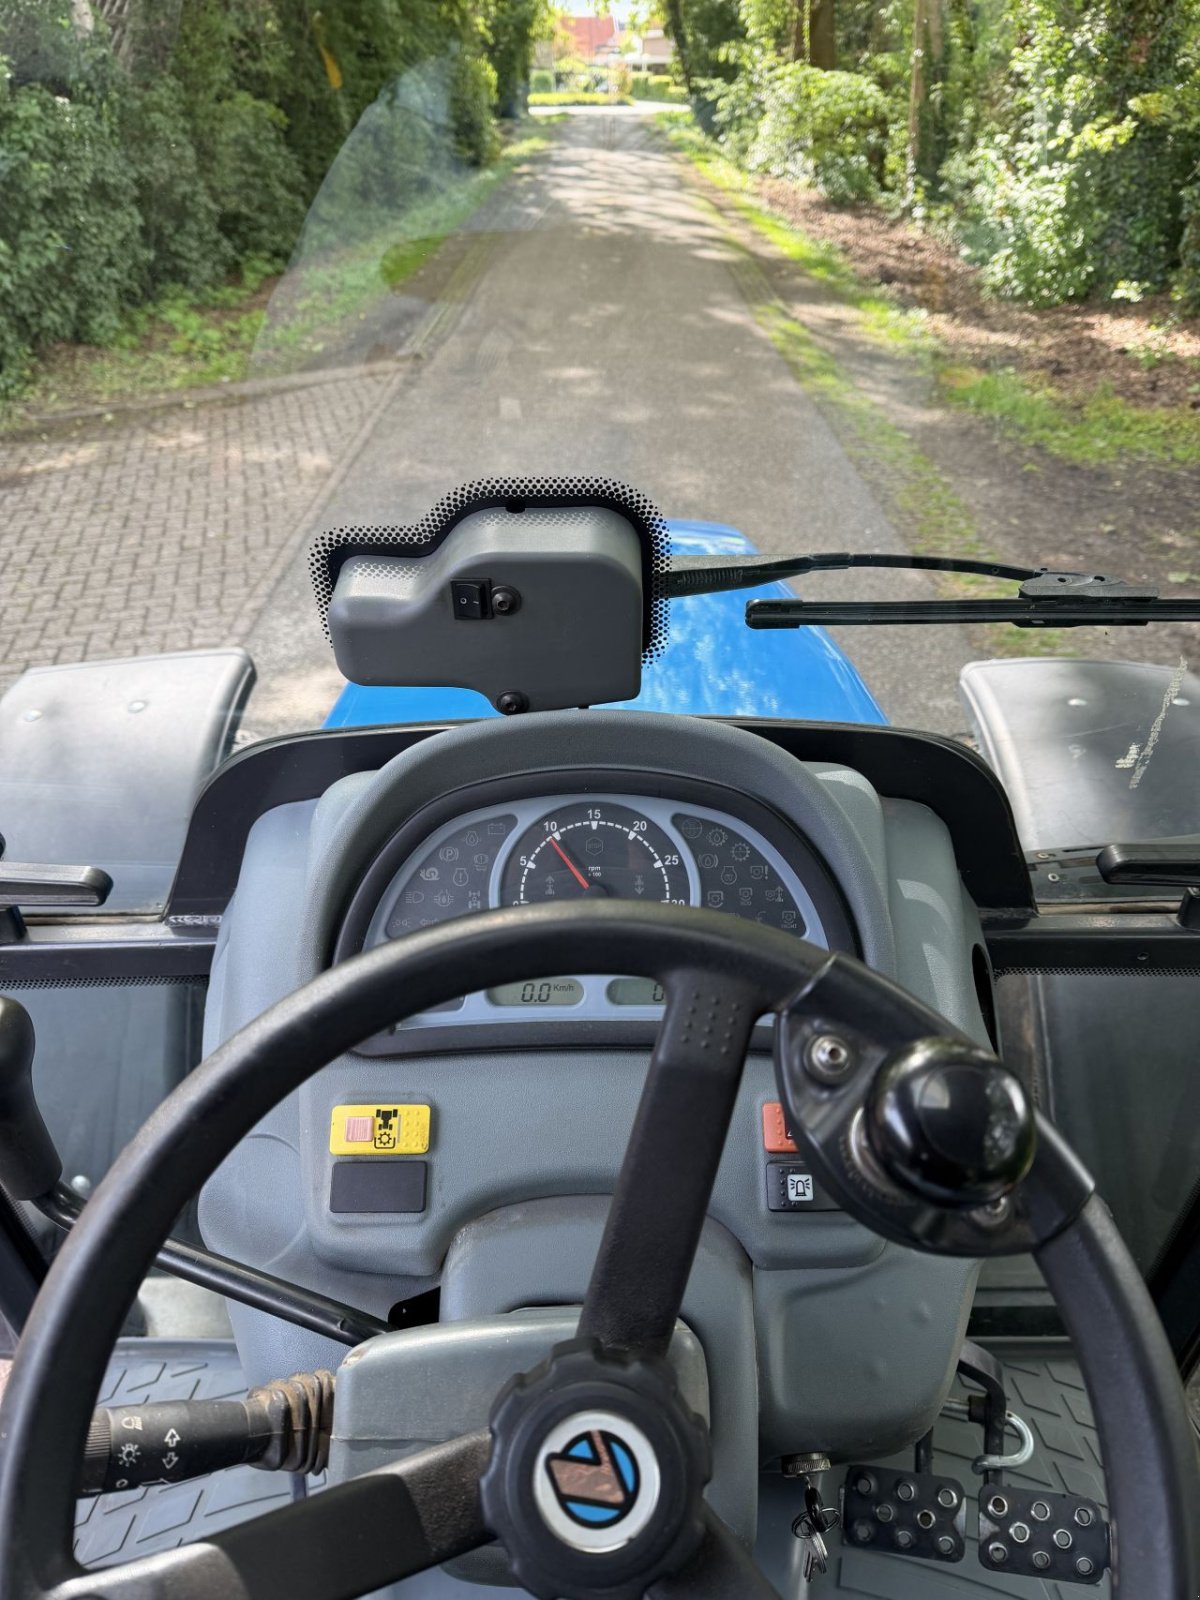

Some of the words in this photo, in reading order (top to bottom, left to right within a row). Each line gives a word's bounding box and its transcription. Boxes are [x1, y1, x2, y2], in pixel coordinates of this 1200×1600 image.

[587, 809, 601, 819] 15
[543, 821, 557, 832] 10
[633, 821, 647, 831] 20
[519, 856, 527, 866] 5
[664, 855, 679, 865] 25
[521, 983, 551, 1002] 0.0
[553, 984, 574, 992] Km/h
